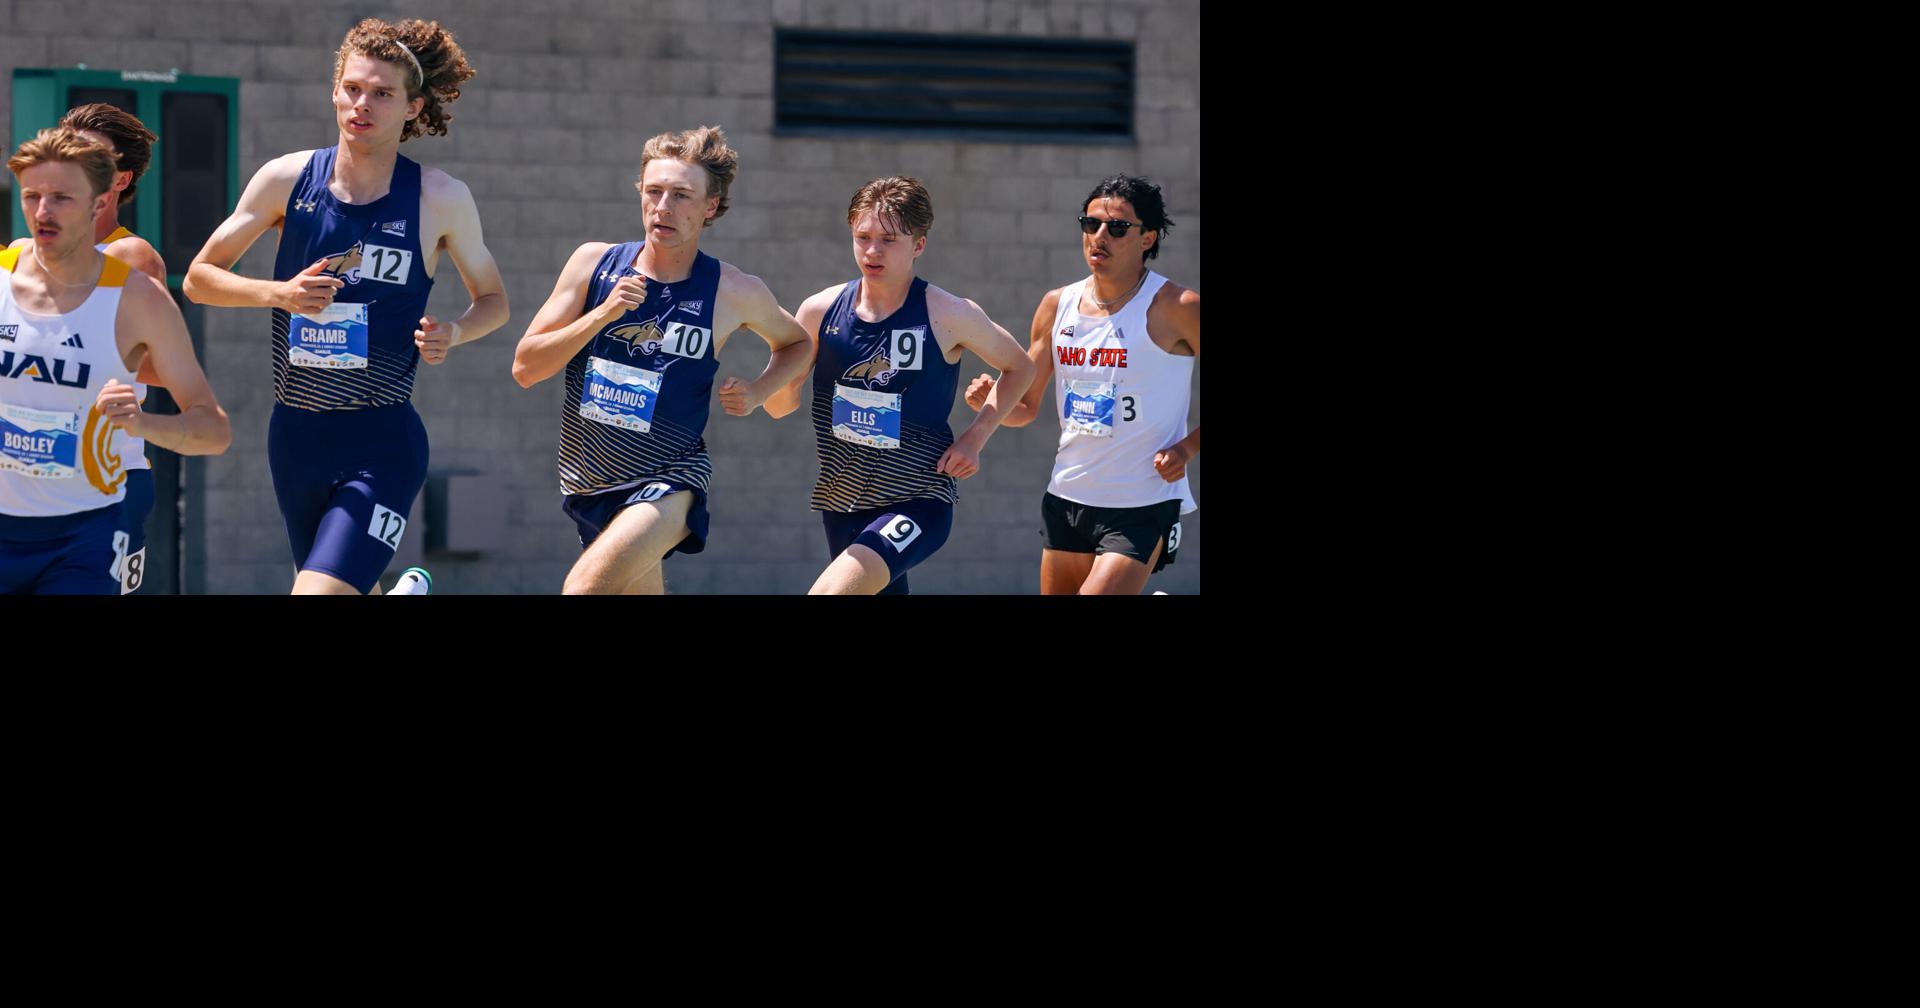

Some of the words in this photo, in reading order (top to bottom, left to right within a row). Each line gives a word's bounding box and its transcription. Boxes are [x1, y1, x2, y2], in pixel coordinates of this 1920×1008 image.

[371, 248, 403, 281] 12
[301, 327, 347, 344] CRAMB
[675, 325, 703, 357] 10
[898, 332, 917, 369] 9
[1090, 348, 1128, 368] STATE
[589, 382, 647, 409] MCMANUS
[851, 410, 876, 426] ELLS
[1121, 396, 1137, 422] 3
[4, 432, 55, 454] BOSLEY
[379, 511, 402, 547] 12
[887, 519, 915, 543] 9
[127, 553, 142, 590] 8
